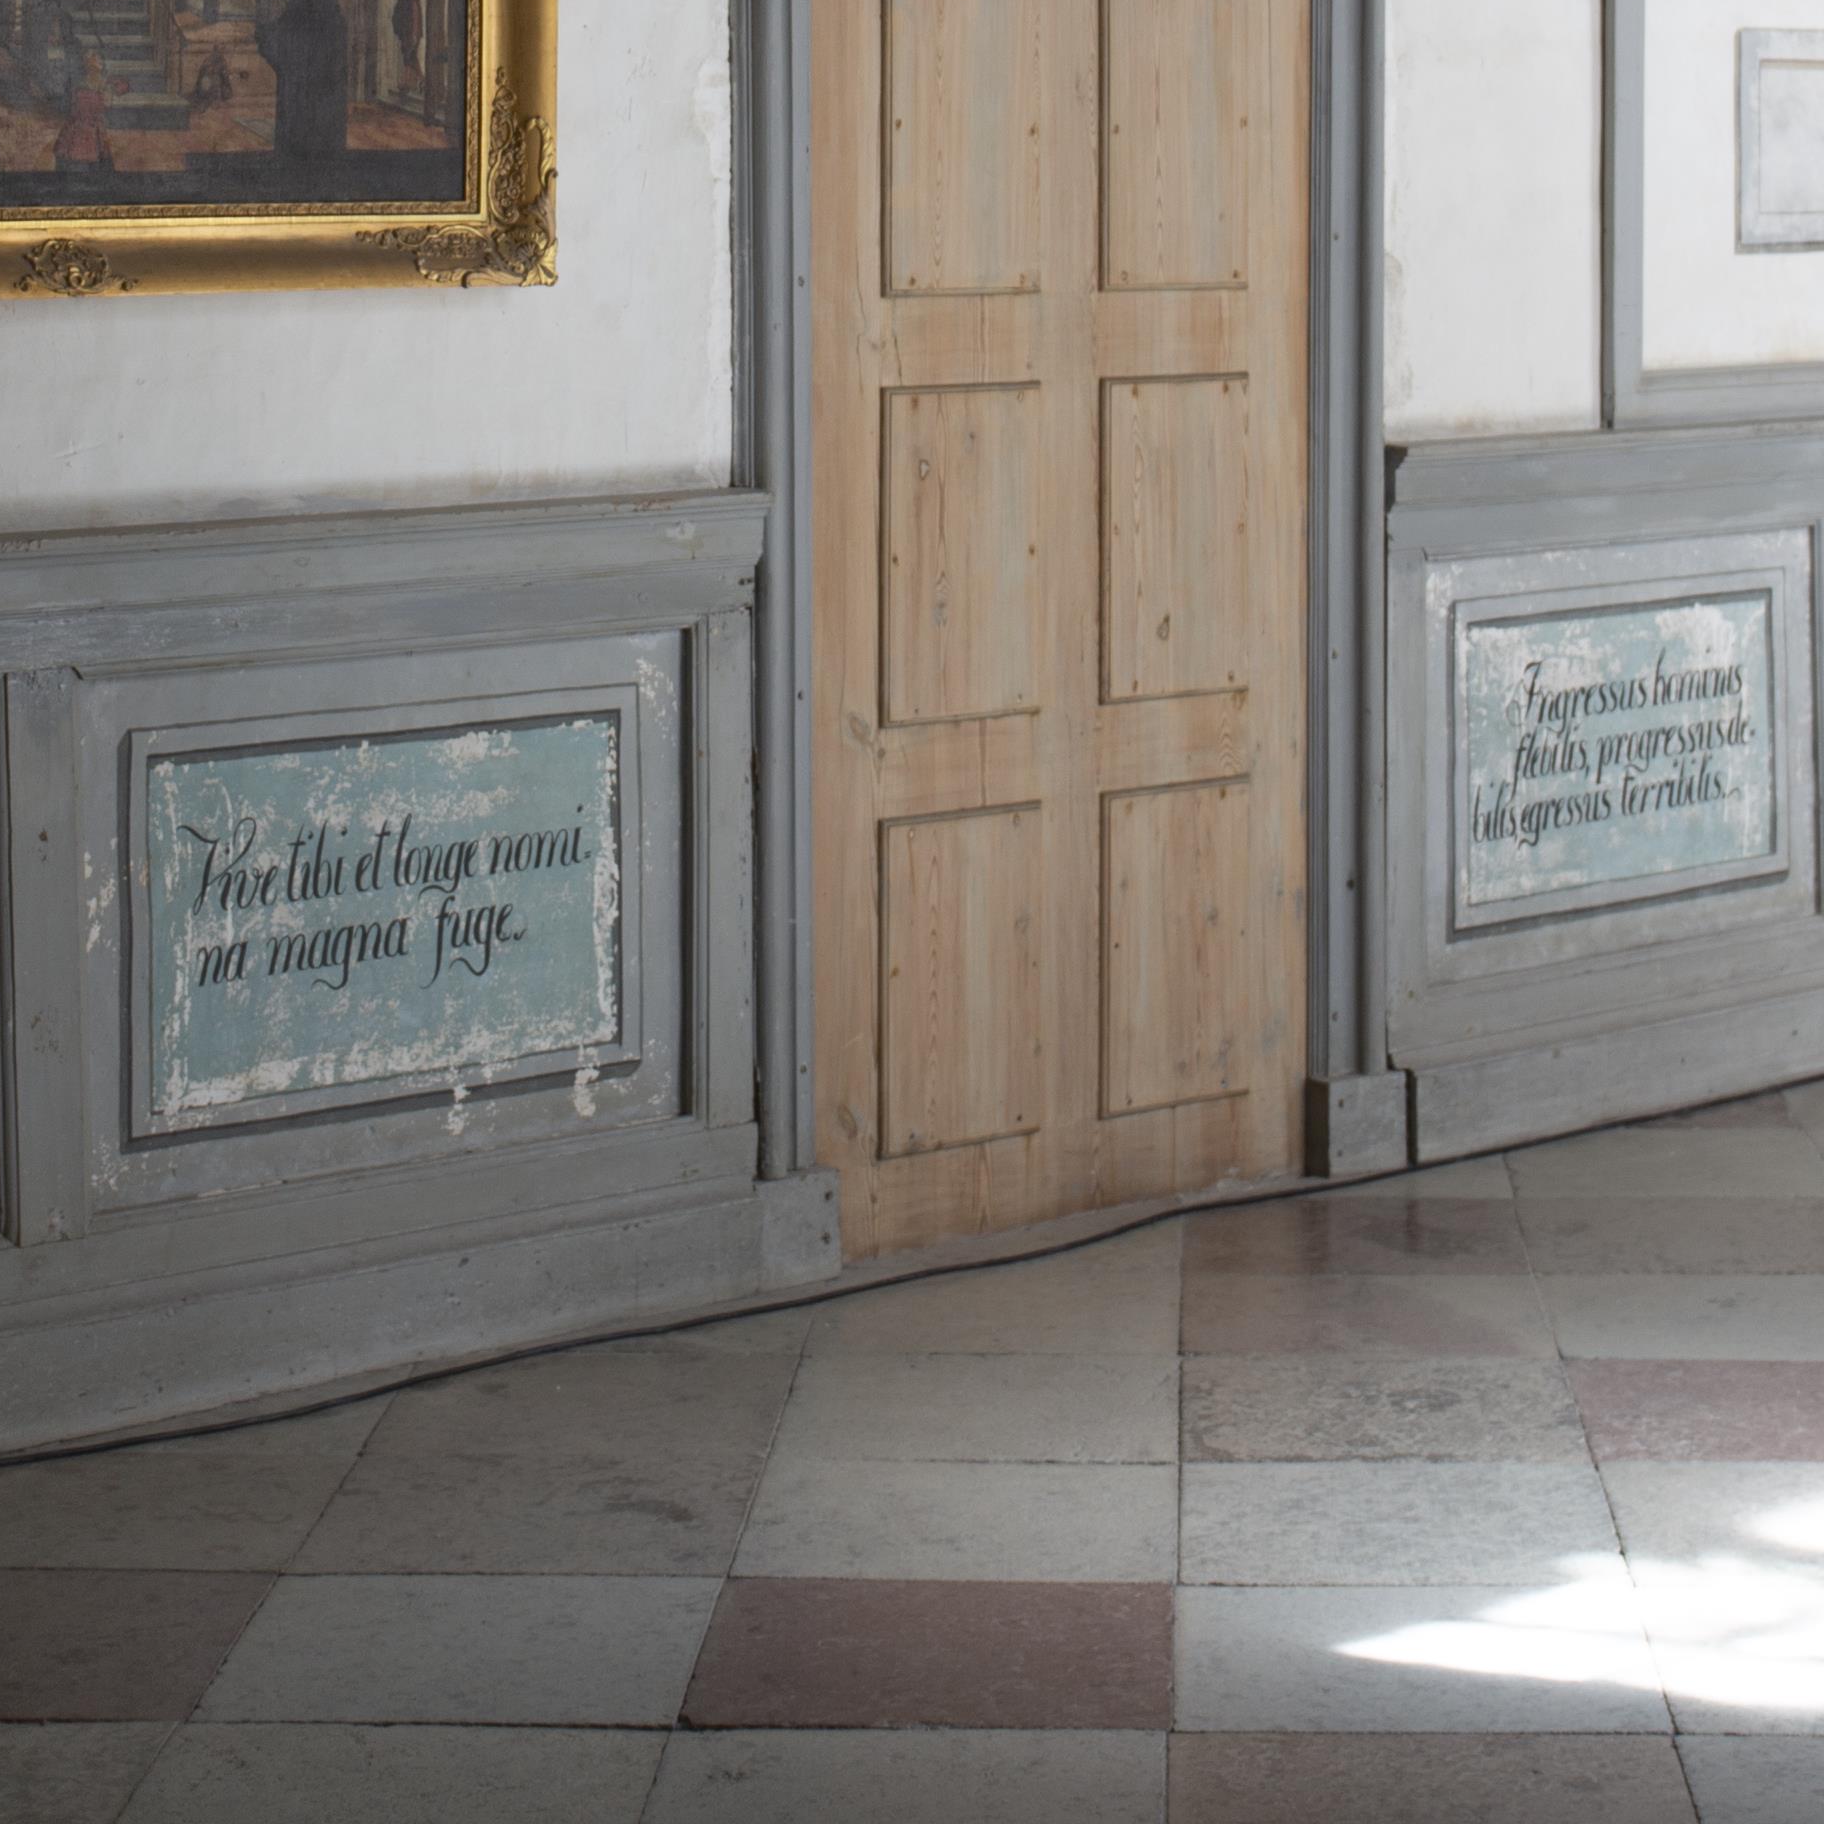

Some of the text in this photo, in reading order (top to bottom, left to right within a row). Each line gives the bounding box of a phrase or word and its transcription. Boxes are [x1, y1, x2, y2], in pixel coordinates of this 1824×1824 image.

[1652, 646, 1743, 706] hominis
[1594, 723, 1724, 785] progressus
[1518, 786, 1612, 850] egressus
[177, 817, 277, 916] Vive
[286, 820, 349, 903] tibi
[354, 819, 391, 892] et
[394, 813, 479, 902] longe
[197, 940, 248, 988] na
[267, 916, 409, 991] magna
